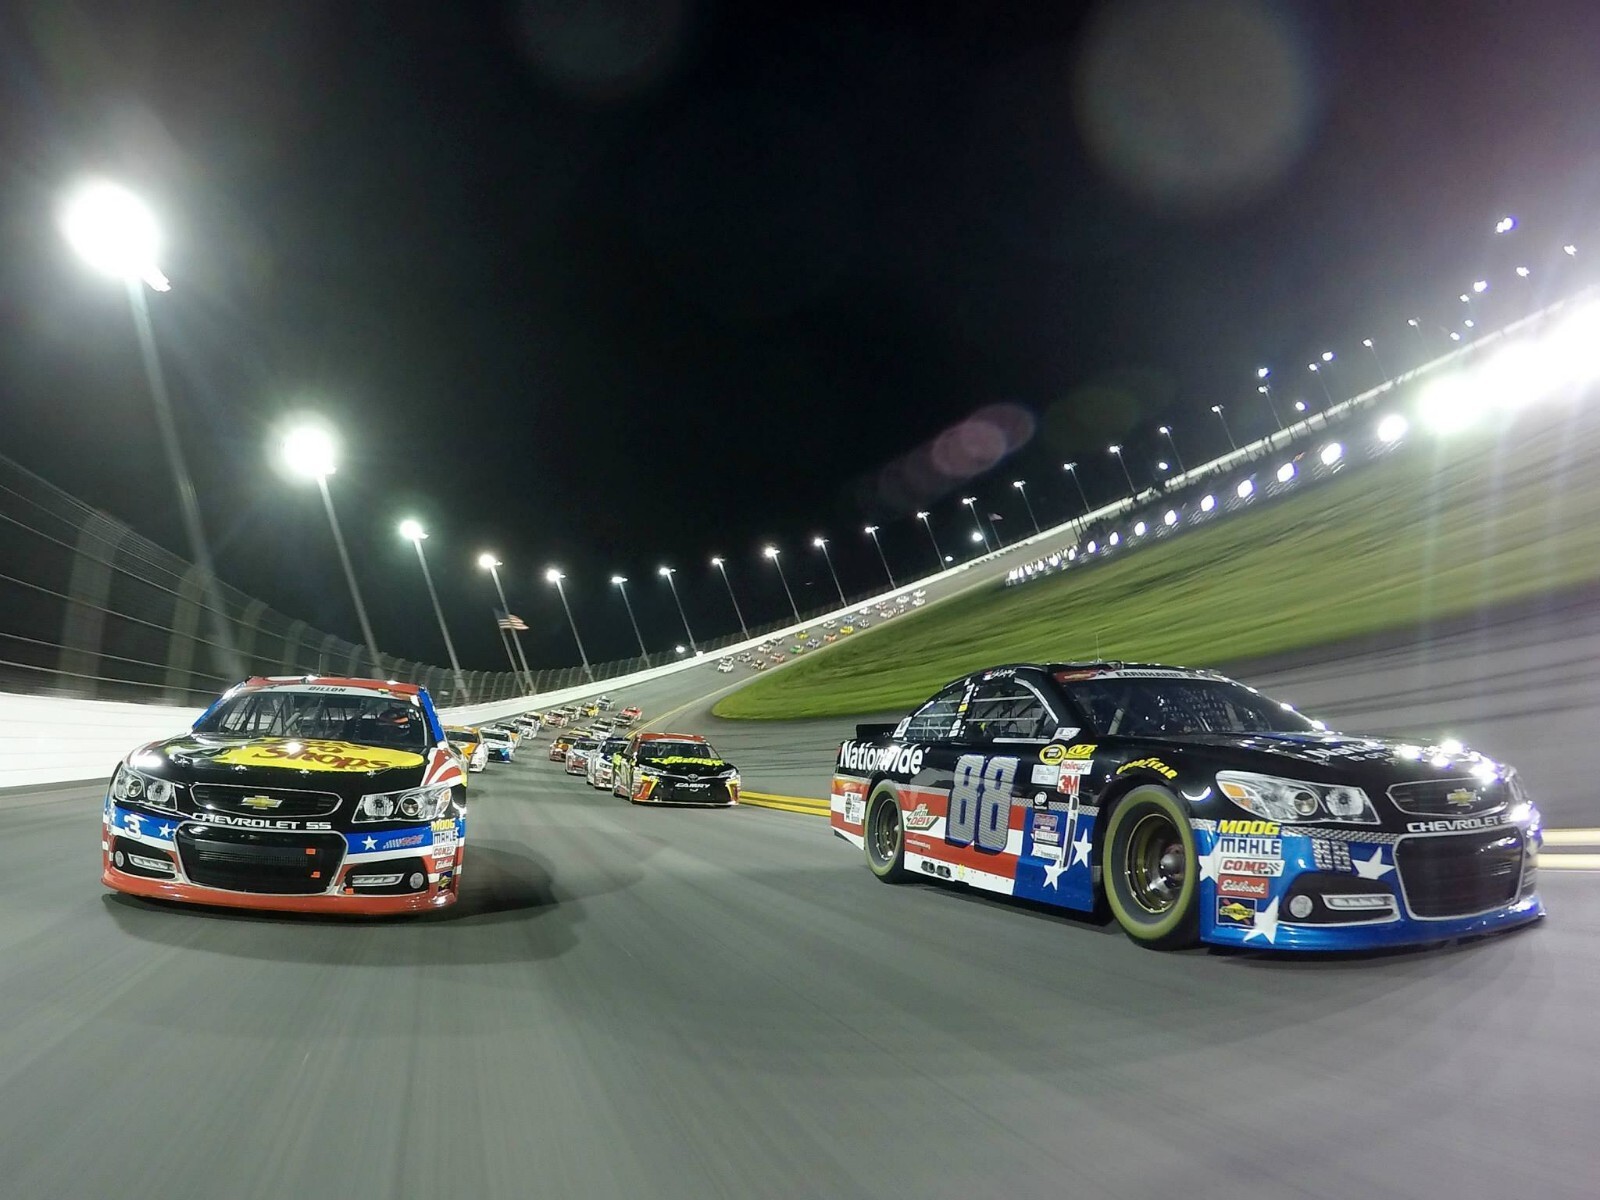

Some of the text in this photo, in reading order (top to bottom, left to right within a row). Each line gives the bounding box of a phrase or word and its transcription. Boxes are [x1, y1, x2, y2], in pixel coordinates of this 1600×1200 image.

[1115, 670, 1183, 679] EARNHARDT
[253, 745, 392, 769] Shops
[839, 739, 922, 775] Nationwide
[1058, 774, 1080, 794] 3M
[949, 753, 1018, 853] 88
[123, 813, 143, 839] 3
[192, 811, 332, 831] CHEVROLET SS
[431, 819, 456, 832] MOOG
[1218, 820, 1280, 835] MOOG
[1406, 815, 1498, 833] CHEVROLET
[1220, 838, 1280, 855] MAHLE
[1311, 838, 1352, 872] 88
[1222, 859, 1268, 872] COMP
[1221, 879, 1266, 894] Edelbrock
[1219, 906, 1255, 918] SUNOCO
